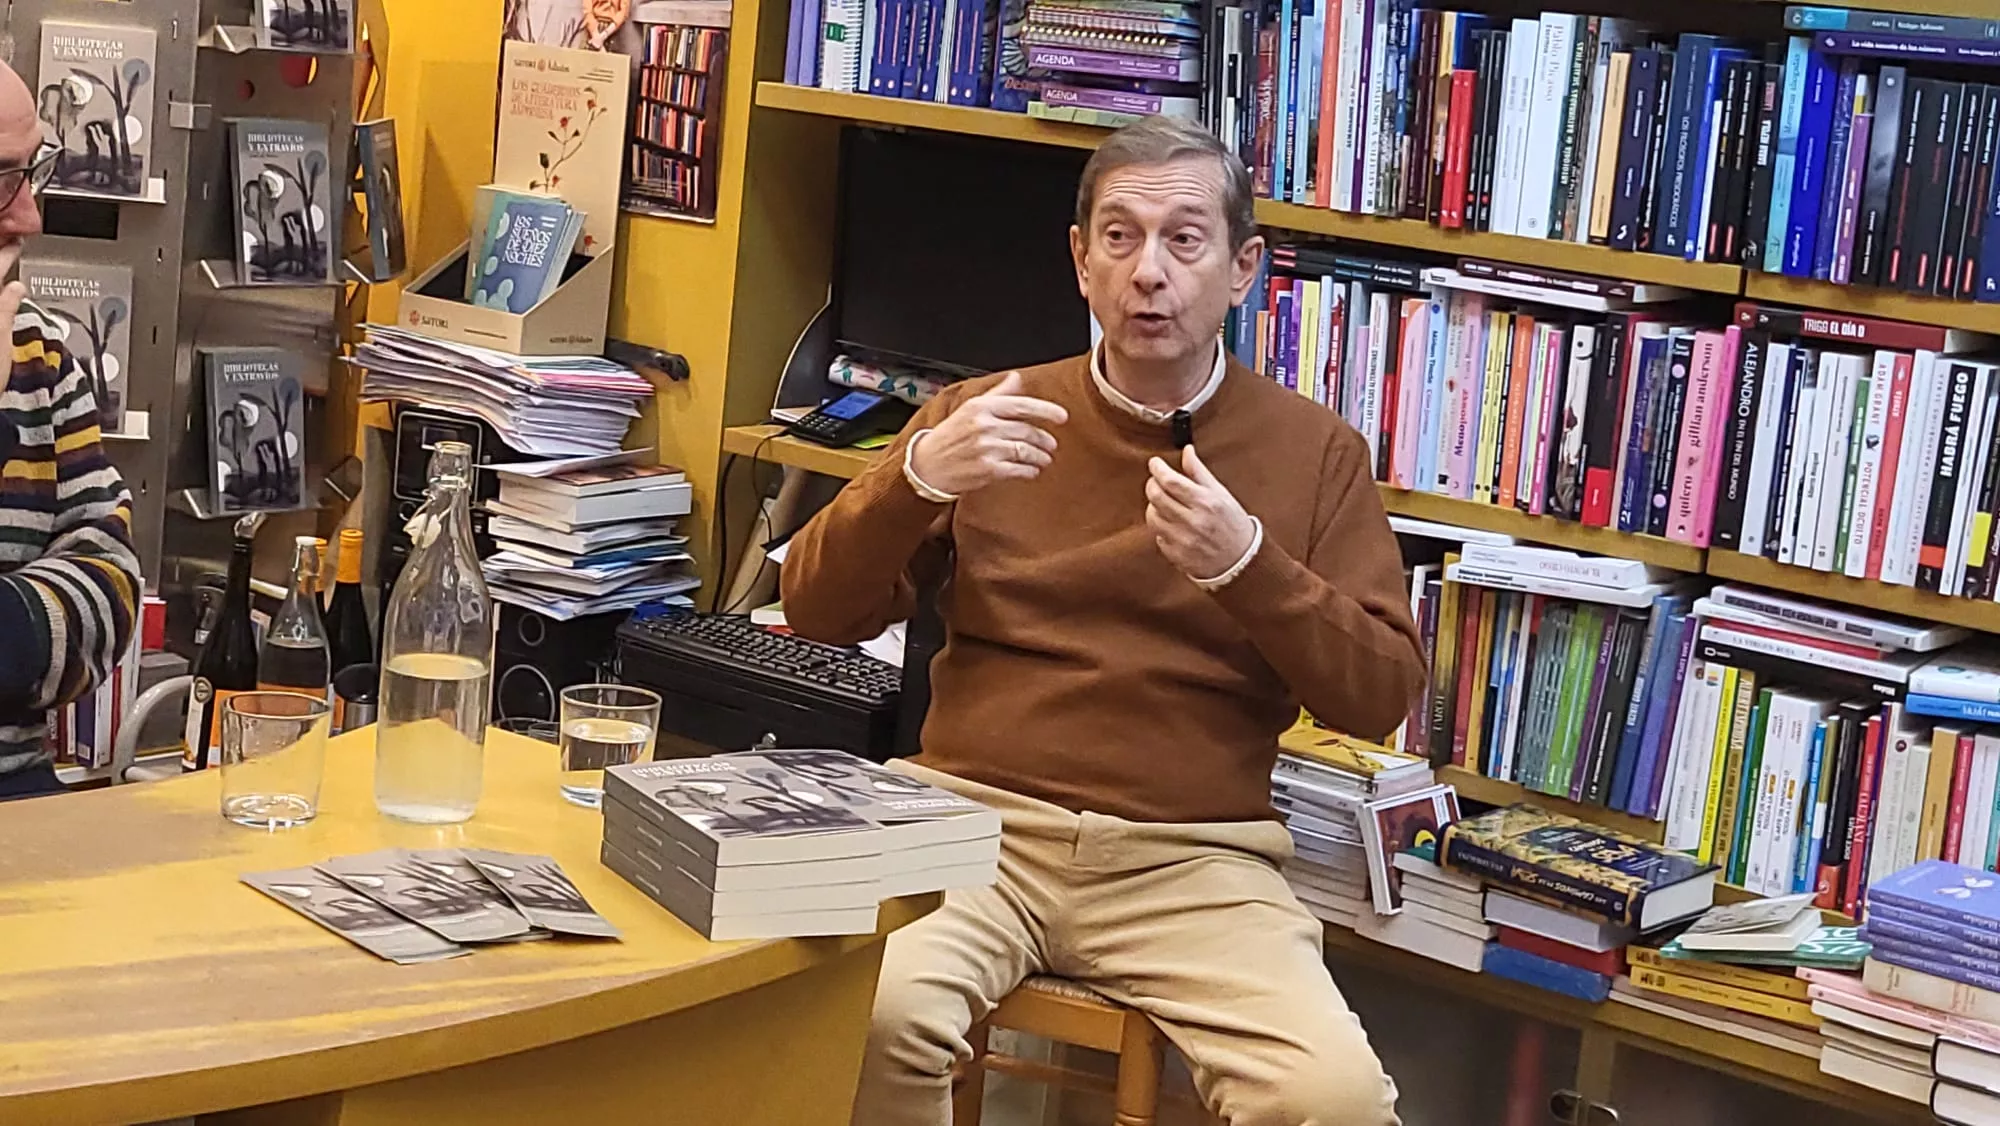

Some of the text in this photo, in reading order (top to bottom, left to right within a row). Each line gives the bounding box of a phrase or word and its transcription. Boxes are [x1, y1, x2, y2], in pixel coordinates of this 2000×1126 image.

[53, 36, 124, 50] BIBLIOTECAS
[61, 46, 123, 60] EXTRAVÍOS
[1035, 52, 1075, 66] AGENDA
[1045, 89, 1078, 102] AGENDA
[247, 133, 304, 143] BIBLIOTECAS
[255, 142, 304, 152] EXTRAVÍOS
[30, 276, 100, 288] BIBLIOTECAS
[40, 287, 100, 298] EXTRAVÍOS
[1830, 321, 1840, 332] EL
[1841, 321, 1857, 336] DÍA
[223, 363, 279, 373] BIBLIOTECAS
[231, 372, 279, 382] EXTRAVÍOS
[1737, 342, 1758, 417] ALEJANDRO
[1872, 393, 1881, 425] GRANT
[1455, 388, 1468, 457] Menopower
[1738, 419, 1746, 430] EN
[1940, 371, 1969, 477] HABRÁ FUEGO
[1680, 342, 1713, 519] quiero gillian anderson
[1737, 431, 1744, 440] EL
[1733, 453, 1741, 466] DEL
[1728, 468, 1739, 500] MUNDO
[1855, 461, 1873, 545] POTENCIAL OCULTO
[1433, 695, 1445, 731] TAROT
[1854, 793, 1869, 843] INVICTO
[1844, 816, 1857, 860] DOCE VIAJES
